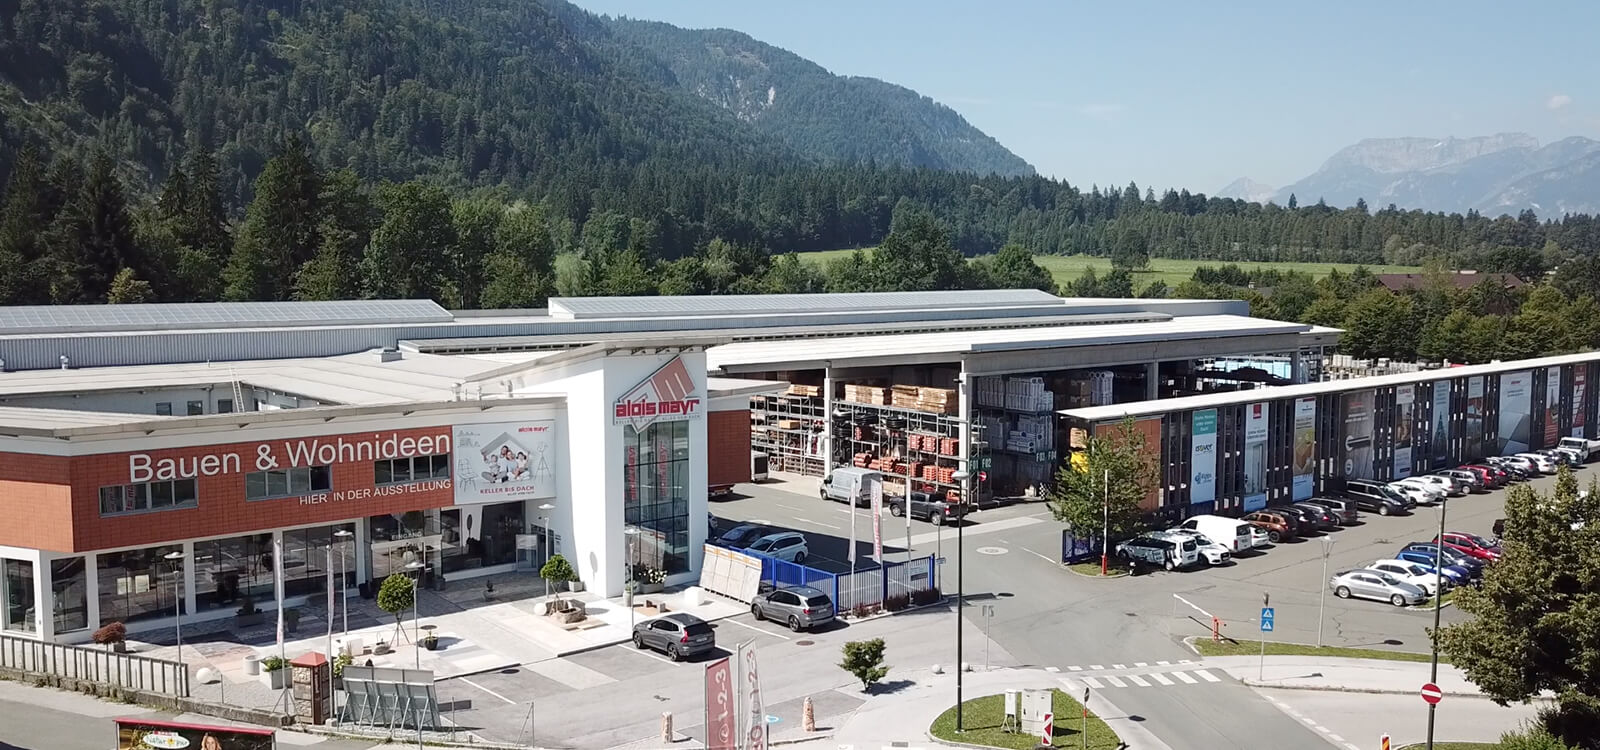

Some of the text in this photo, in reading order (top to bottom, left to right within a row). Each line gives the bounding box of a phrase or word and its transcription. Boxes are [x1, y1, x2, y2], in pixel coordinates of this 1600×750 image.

[615, 399, 700, 417] alois mayr
[129, 433, 450, 483] Bauen & Wohnideen
[981, 458, 992, 468] F02
[299, 479, 451, 505] HIER IN DER AUSSTELLUNG
[715, 668, 728, 721] 1-2-3
